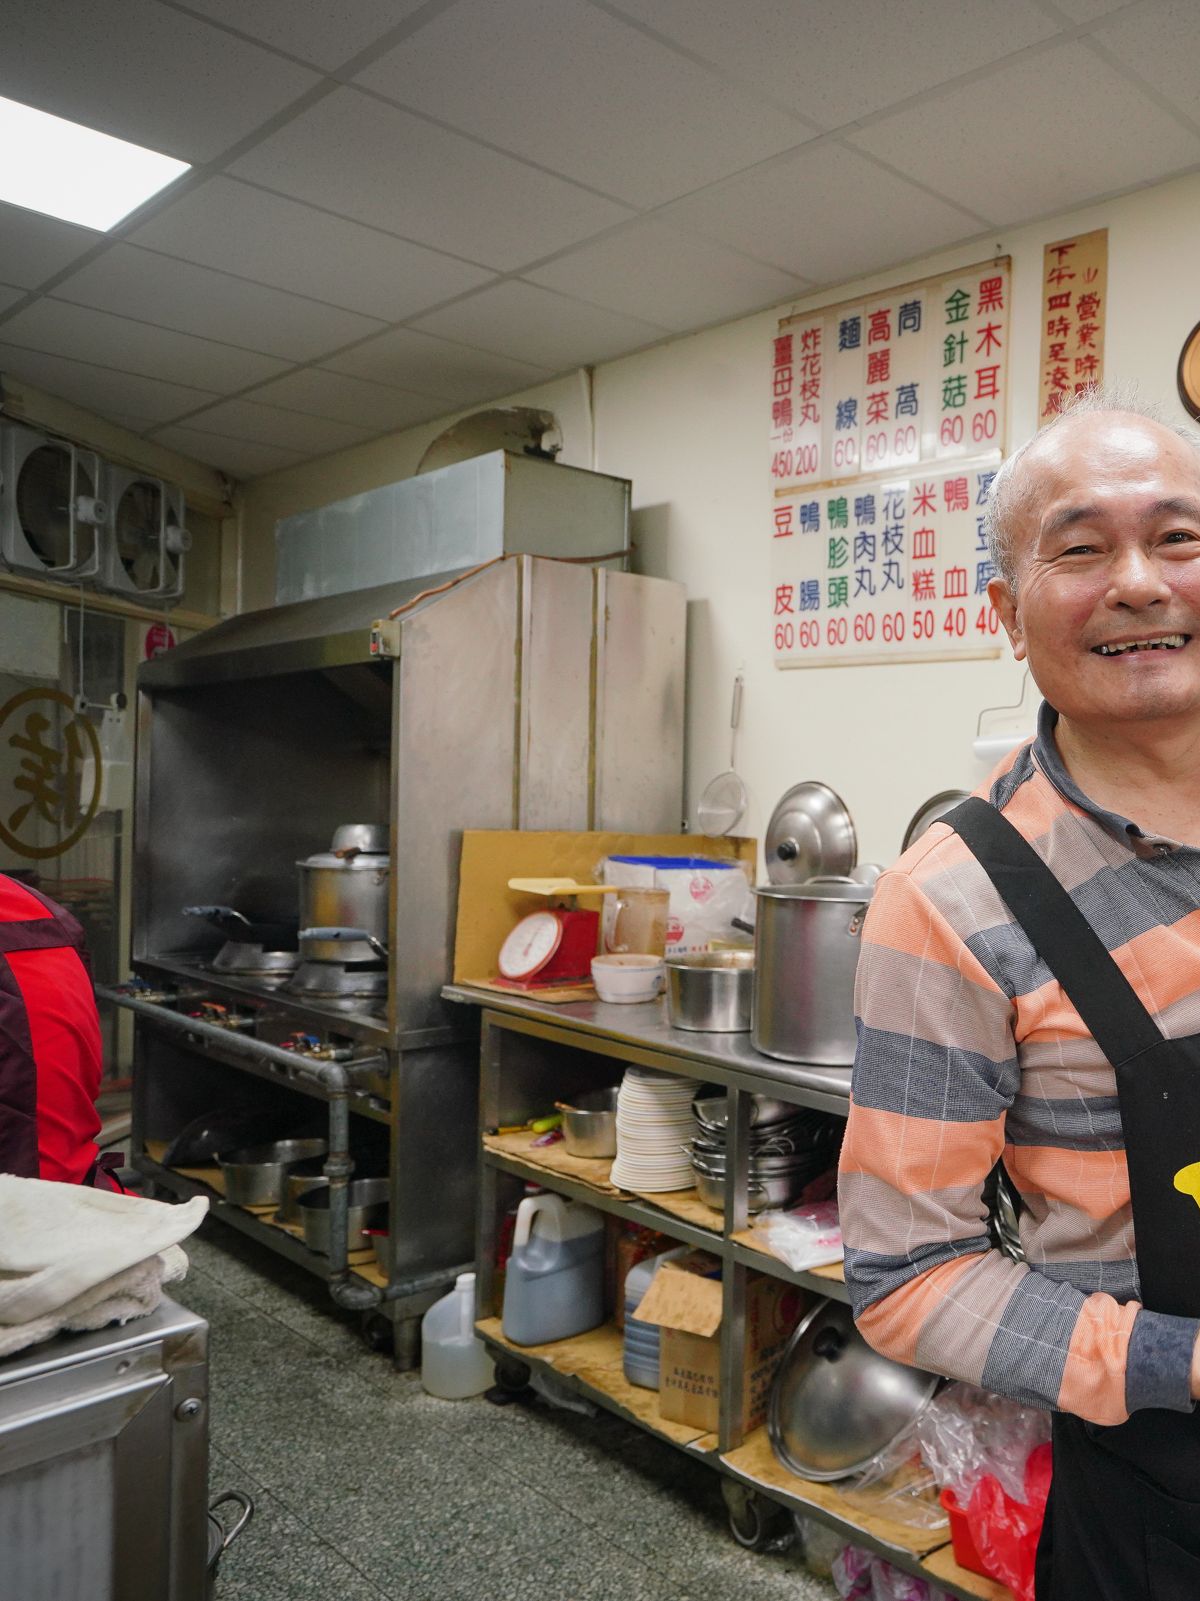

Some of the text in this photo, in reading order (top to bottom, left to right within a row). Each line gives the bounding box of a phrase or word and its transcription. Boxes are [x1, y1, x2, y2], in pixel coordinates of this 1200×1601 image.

[942, 289, 971, 411] 金針菇
[973, 277, 1004, 401] 黑木耳
[799, 328, 822, 427] 炸花枝丸
[835, 316, 861, 431] 麵線
[866, 308, 892, 425] 高麗菜
[894, 425, 916, 456] 60
[940, 415, 964, 447] 60
[972, 410, 997, 443] 60
[771, 449, 793, 478] 450
[795, 444, 818, 476] 200
[834, 437, 855, 467] 60
[866, 432, 887, 463] 60
[853, 493, 877, 599] 鴨肉丸
[881, 488, 906, 593] 花枝丸
[912, 482, 937, 602] 米血糕
[943, 476, 969, 600] 鴨血
[773, 504, 795, 616] 豆皮
[799, 501, 820, 612] 鴨腸
[775, 622, 794, 650] 60
[800, 620, 820, 648] 60
[827, 617, 848, 646] 60
[853, 612, 875, 642] 60
[882, 612, 905, 642] 60
[912, 609, 934, 640] 50
[943, 607, 966, 637] 40
[975, 606, 999, 635] 40
